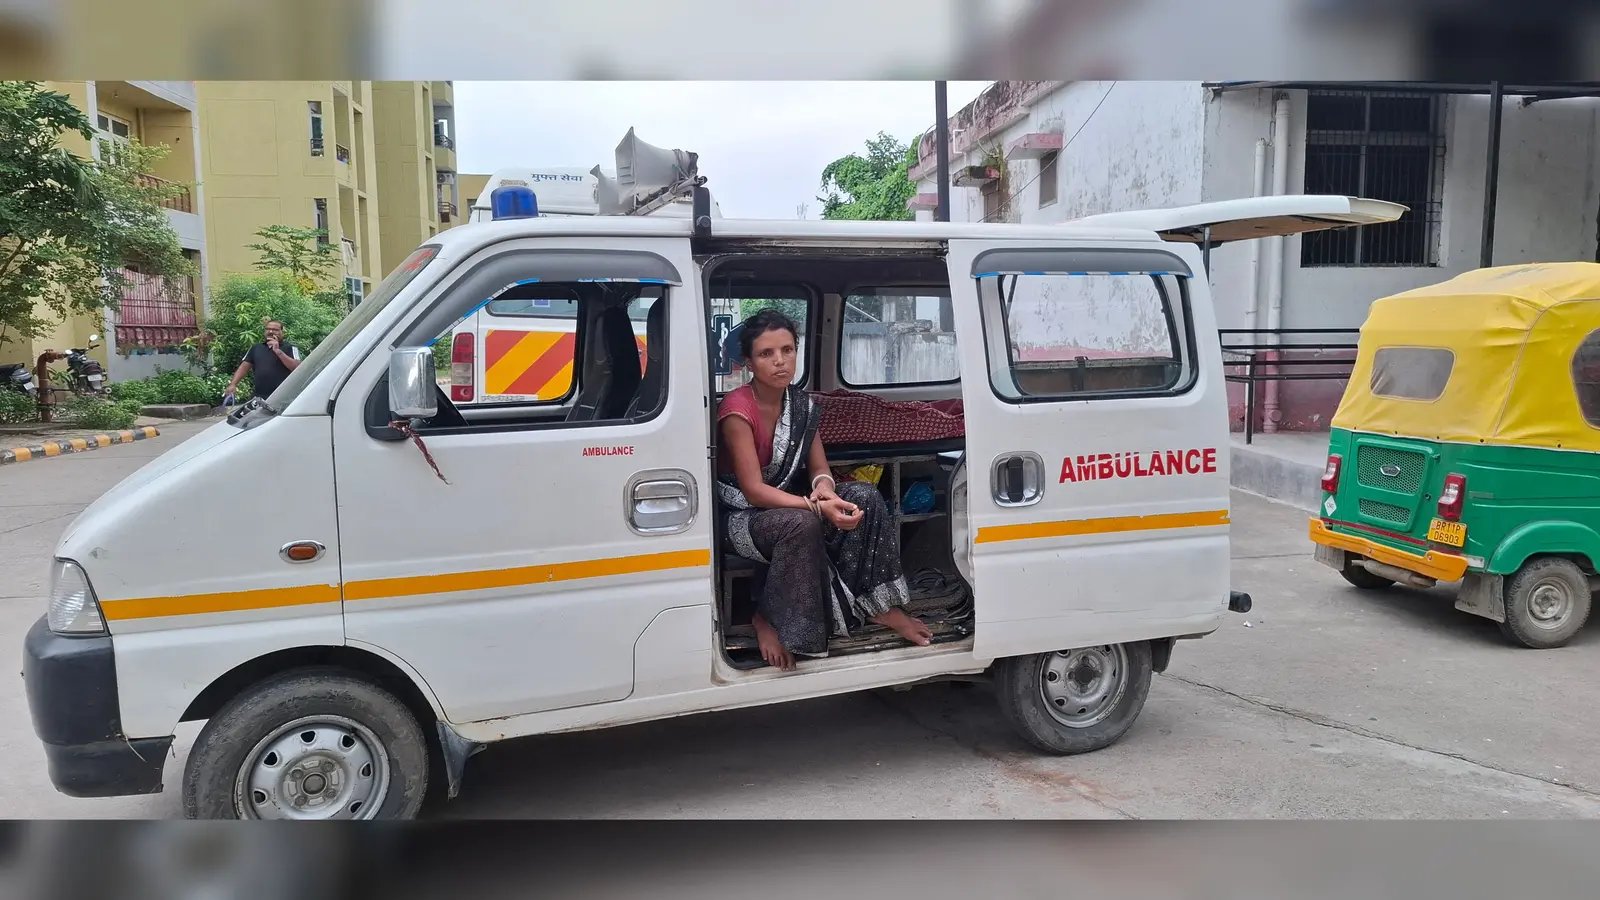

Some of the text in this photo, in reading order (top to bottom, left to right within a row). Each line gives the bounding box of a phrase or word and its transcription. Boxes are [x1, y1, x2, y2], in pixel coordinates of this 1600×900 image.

[559, 173, 584, 182] सेवा
[582, 446, 634, 457] AMBULANCE
[1059, 448, 1217, 484] AMBULANCE
[1435, 521, 1461, 534] BR11P
